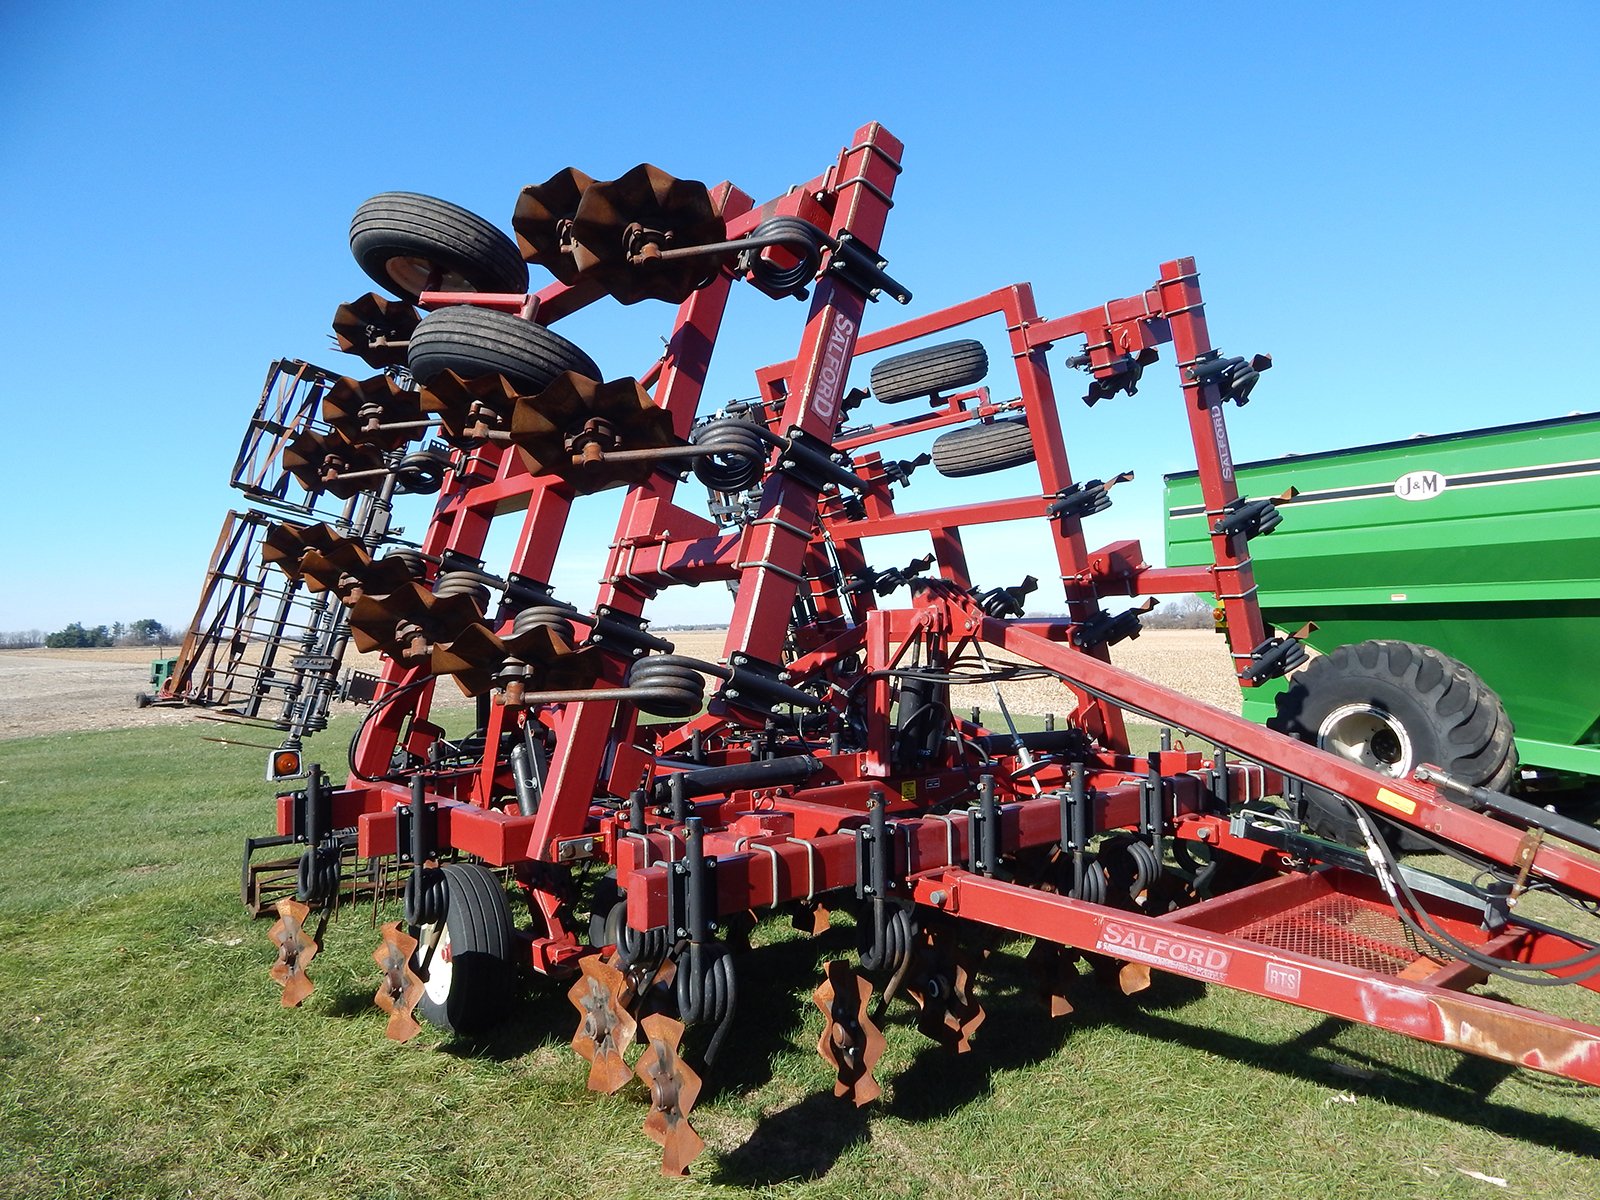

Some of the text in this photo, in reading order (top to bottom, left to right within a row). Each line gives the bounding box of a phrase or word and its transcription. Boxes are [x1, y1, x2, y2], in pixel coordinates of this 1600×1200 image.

[814, 313, 854, 417] SALFORD
[1211, 405, 1232, 479] SALFORD
[1399, 474, 1438, 496] J&M
[1103, 922, 1227, 970] SALFORD
[1270, 970, 1296, 990] RTS
